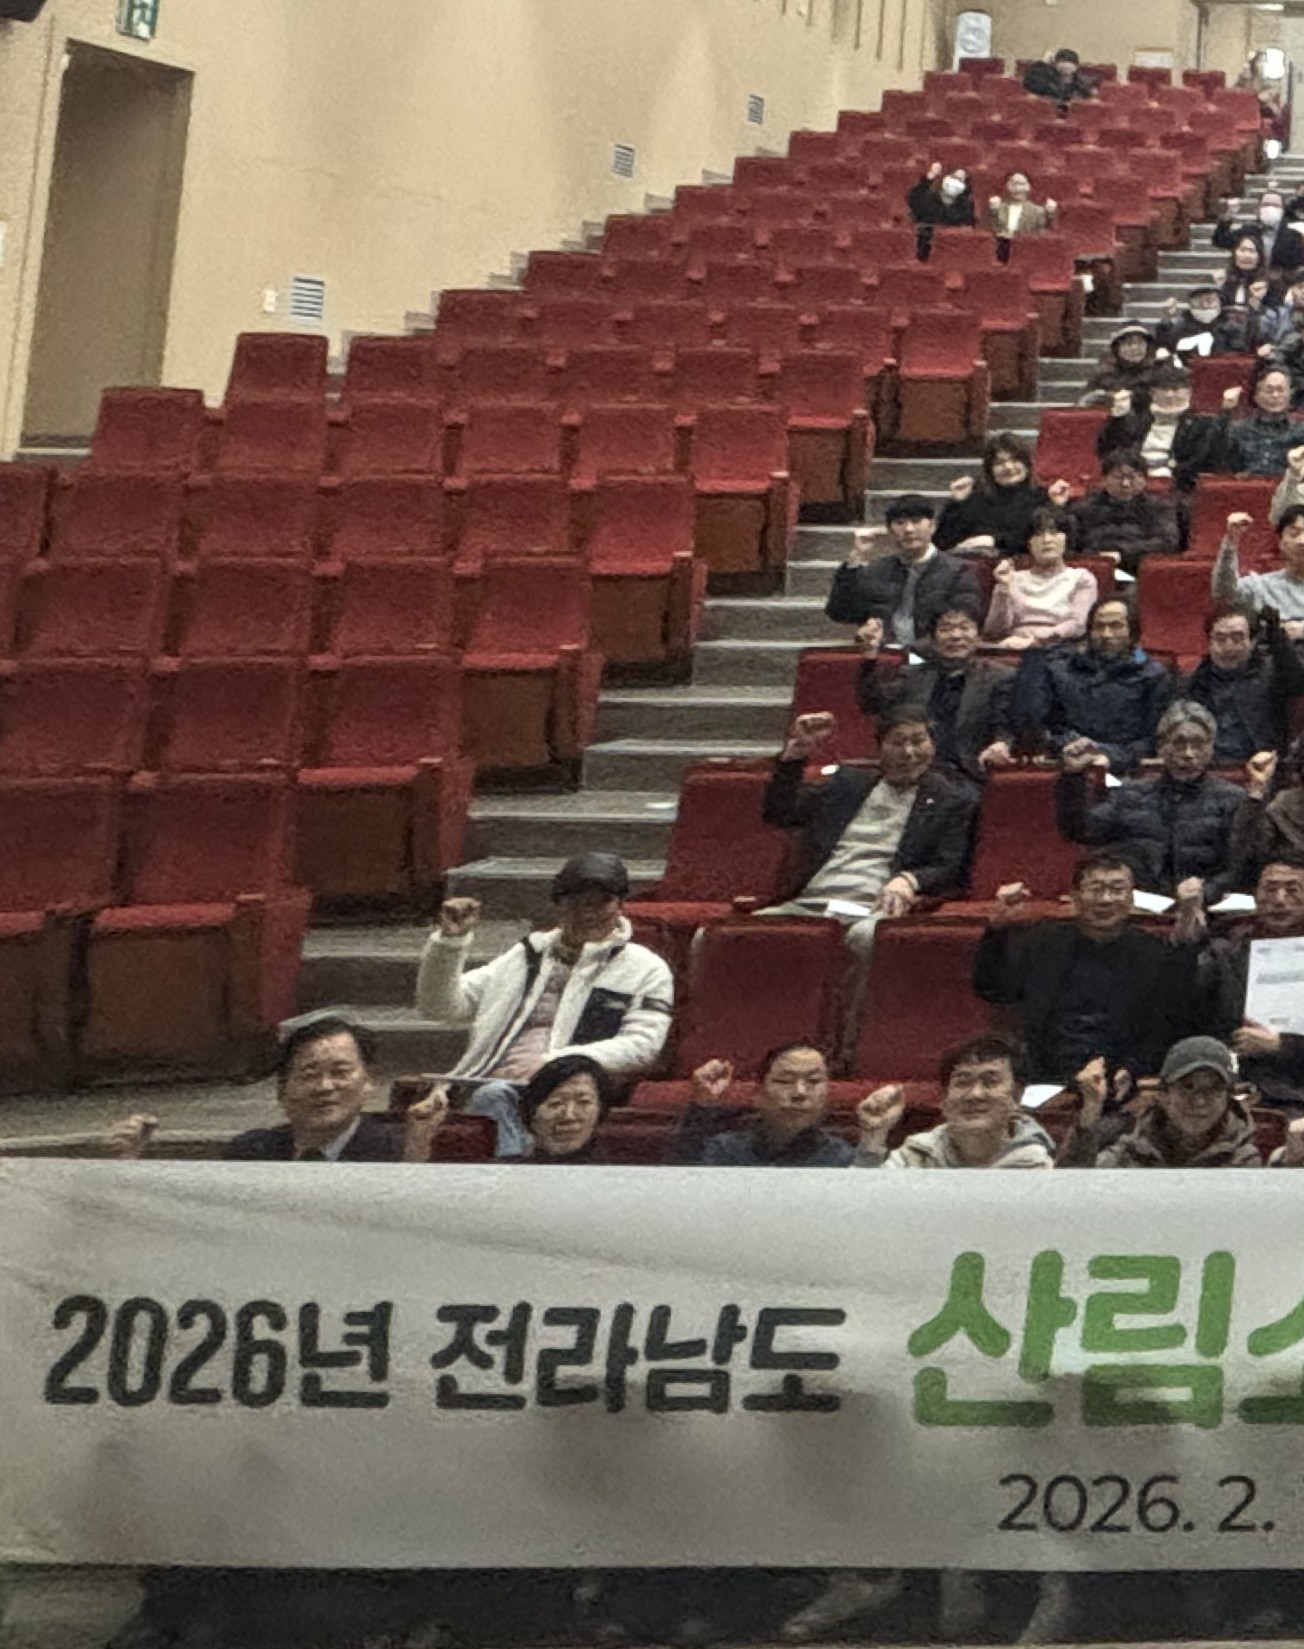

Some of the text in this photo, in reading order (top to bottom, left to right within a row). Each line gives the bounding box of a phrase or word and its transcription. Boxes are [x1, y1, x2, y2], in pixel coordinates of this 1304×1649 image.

[43, 1293, 394, 1410] 2026년
[430, 1301, 848, 1415] 전라남도
[996, 1472, 1196, 1534] 2026.
[1216, 1474, 1276, 1534] 2.
